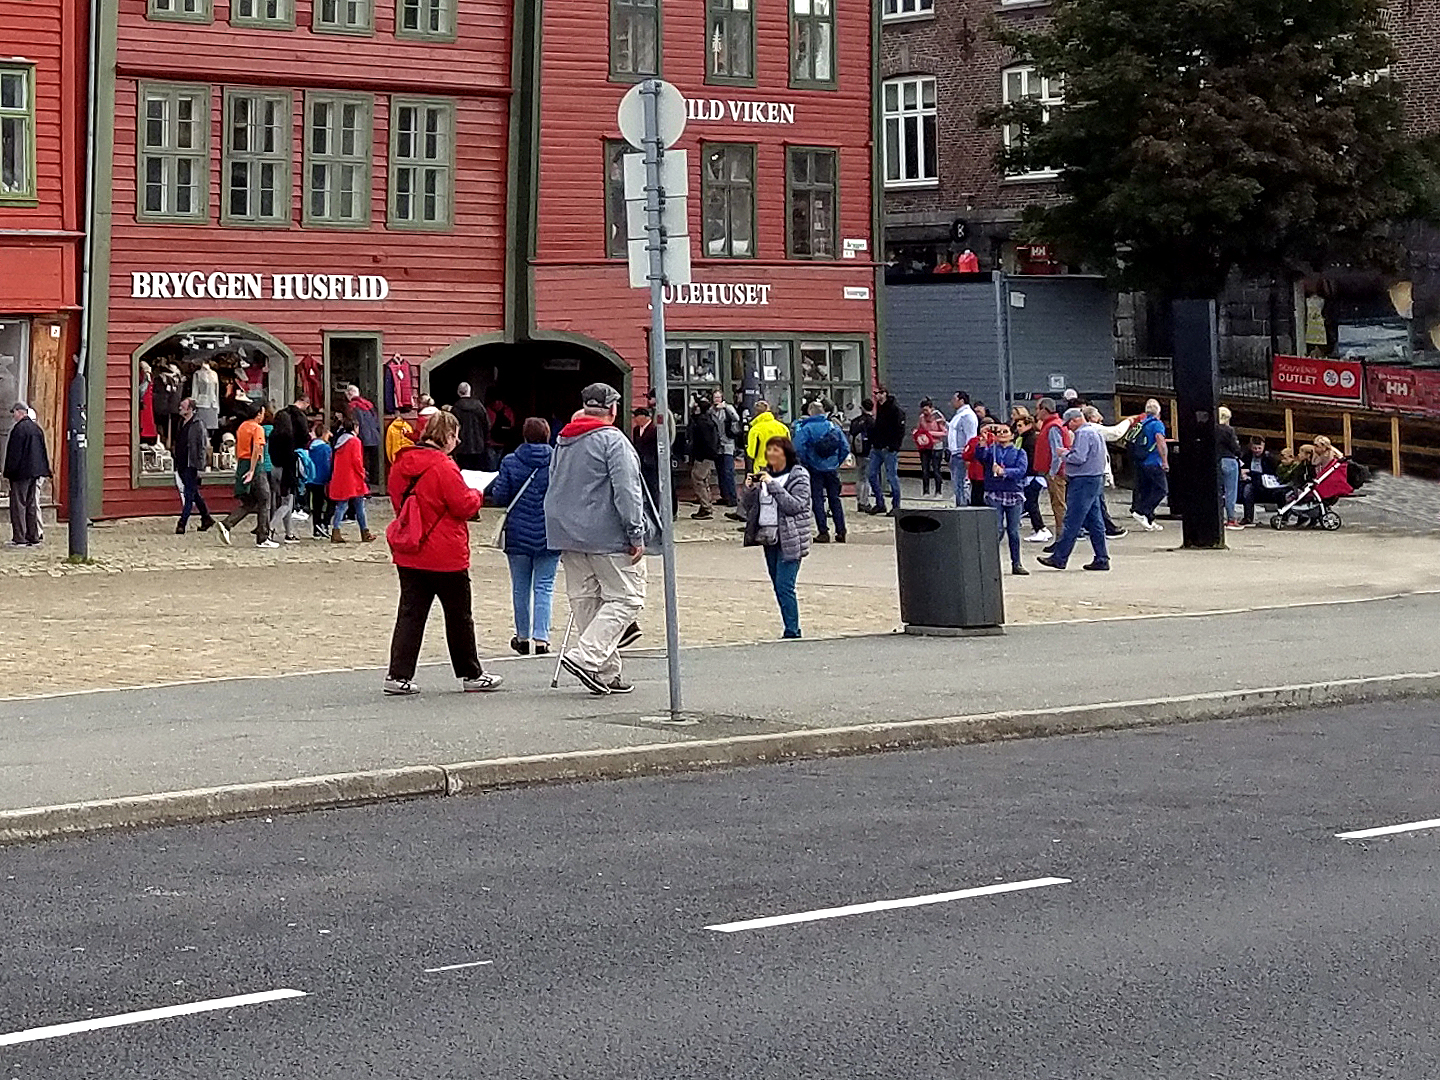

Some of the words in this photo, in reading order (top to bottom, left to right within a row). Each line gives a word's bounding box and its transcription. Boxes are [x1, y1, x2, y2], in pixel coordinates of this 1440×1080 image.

[683, 98, 725, 120] ILD
[727, 100, 795, 123] VIKEN
[131, 271, 262, 299] BRYGGEN
[272, 273, 389, 300] HUSFLID
[647, 283, 771, 309] ULEHUSET
[1278, 373, 1317, 385] OUTLET
